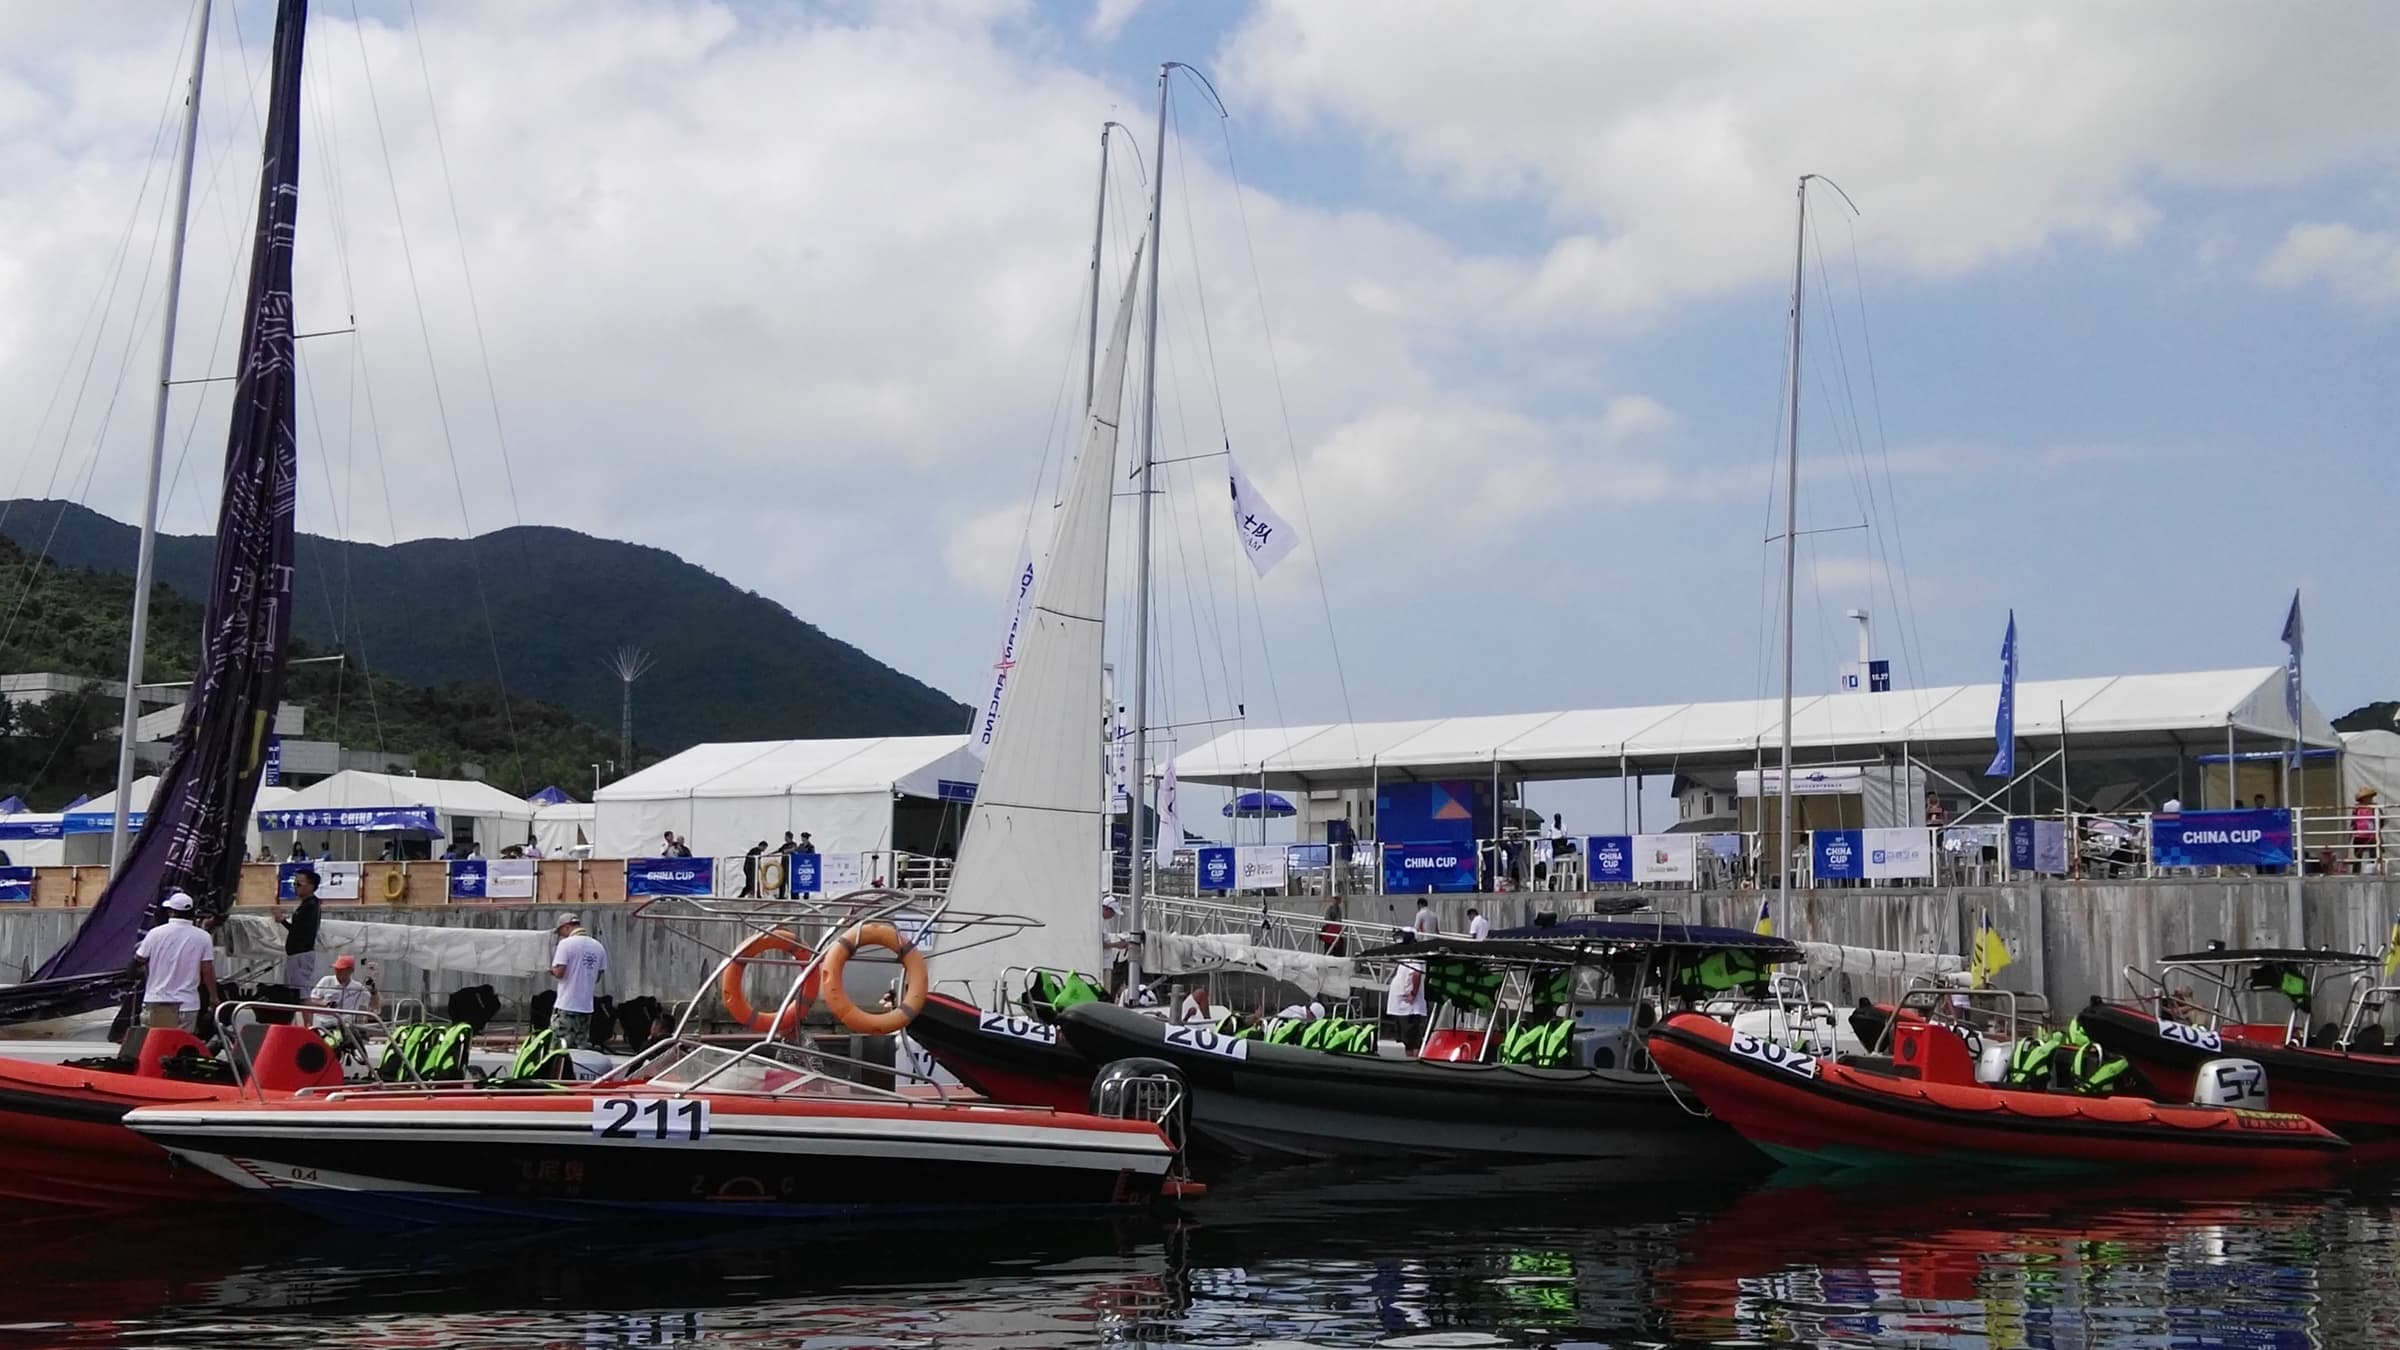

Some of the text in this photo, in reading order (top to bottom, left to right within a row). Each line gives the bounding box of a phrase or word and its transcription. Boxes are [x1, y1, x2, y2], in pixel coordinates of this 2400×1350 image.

[2182, 829, 2262, 844] CHINA CUP
[1598, 852, 1623, 861] CHINA
[1825, 847, 1852, 856] CHINA
[1404, 857, 1458, 869] CHINA CUP
[1602, 860, 1619, 868] CUP
[1830, 855, 1848, 864] CUP
[1207, 863, 1228, 871] CHINA
[647, 871, 695, 881] CHINA CUP
[981, 1014, 1055, 1042] 204
[2161, 1023, 2220, 1050] 203
[1734, 1031, 1815, 1076] 302
[600, 1098, 703, 1141] 211
[291, 1167, 318, 1181] 0.4
